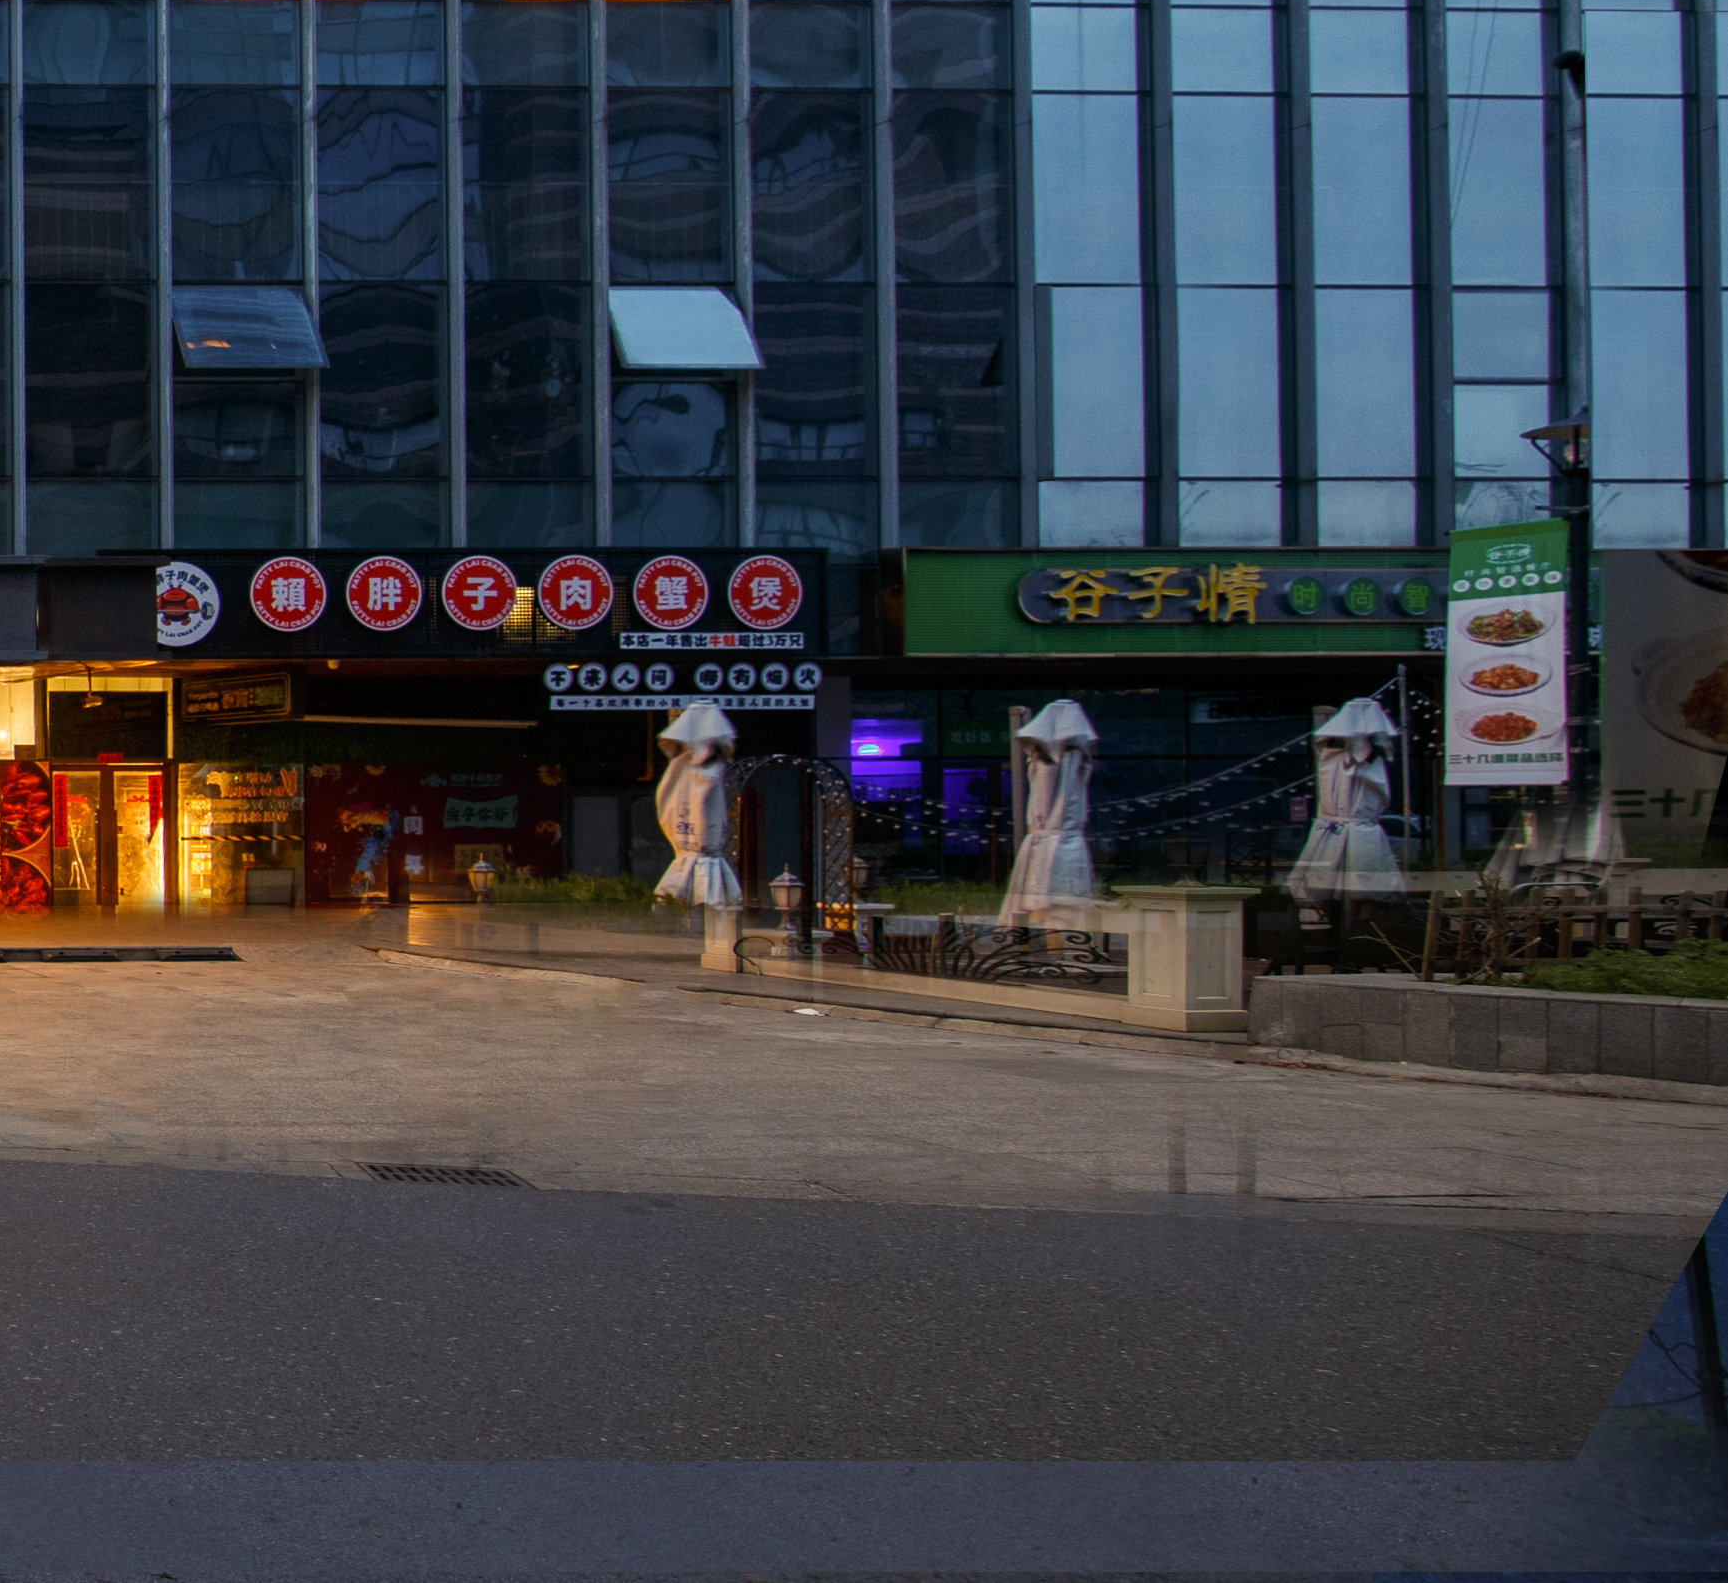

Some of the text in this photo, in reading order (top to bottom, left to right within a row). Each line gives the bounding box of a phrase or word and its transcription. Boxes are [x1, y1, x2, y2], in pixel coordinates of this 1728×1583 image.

[1050, 563, 1429, 624] 谷子情 时尚智
[1448, 752, 1564, 765] 三十几道菜品选择
